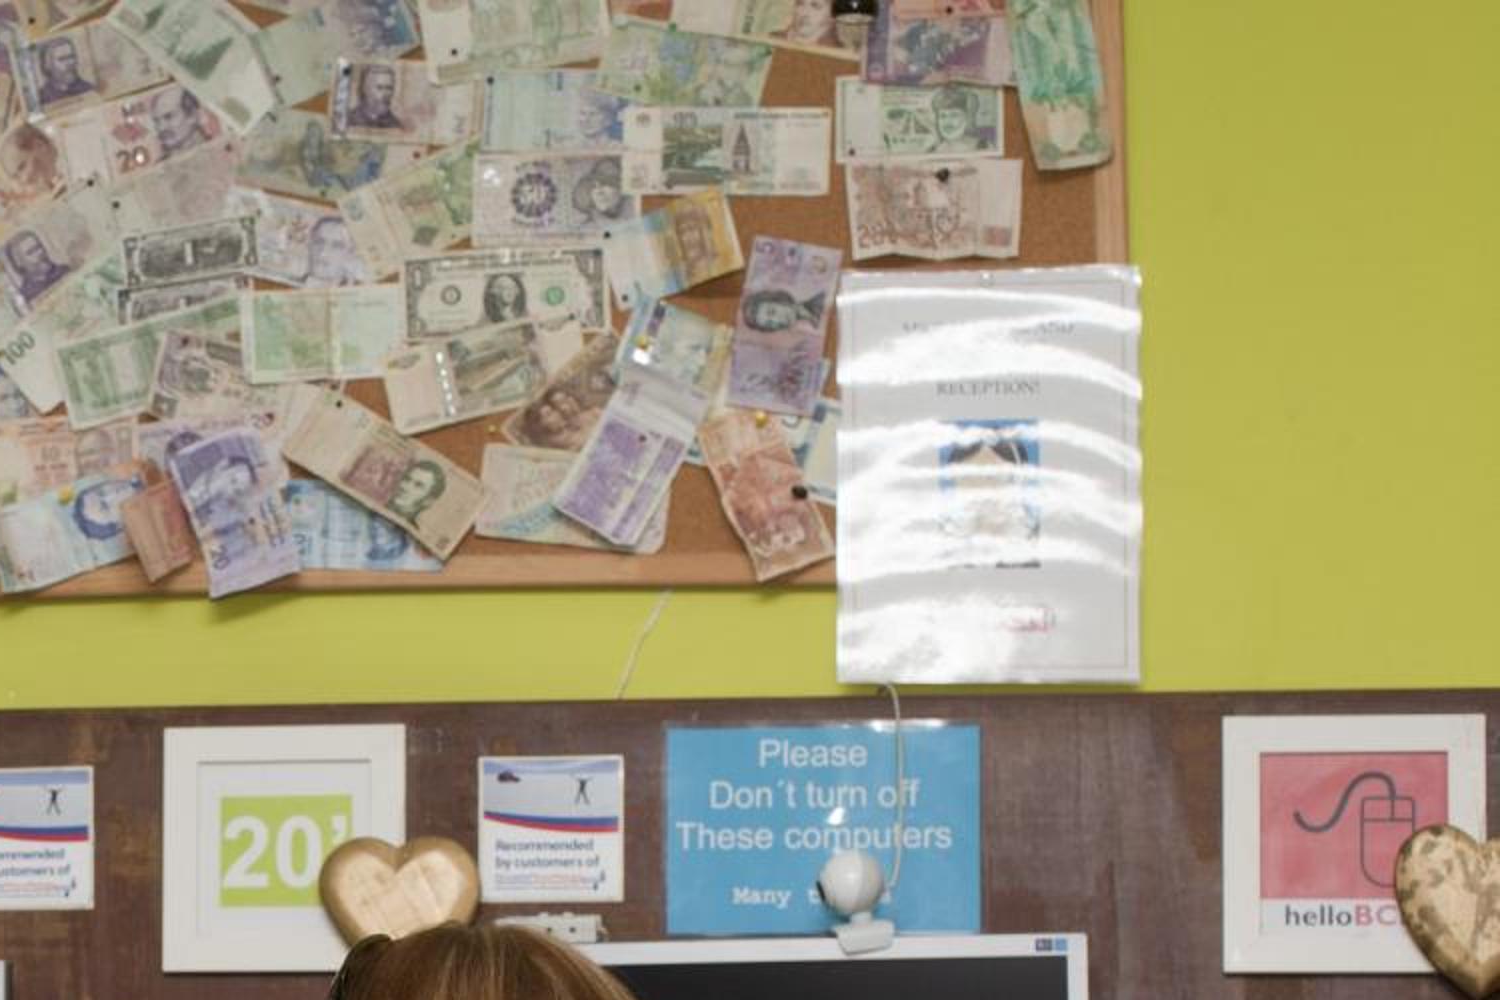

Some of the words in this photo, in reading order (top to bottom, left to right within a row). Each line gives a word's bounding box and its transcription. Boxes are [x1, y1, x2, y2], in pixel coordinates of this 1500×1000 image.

[758, 738, 868, 768] Please
[806, 780, 867, 808] turn
[877, 778, 920, 808] off
[675, 822, 773, 850] These
[784, 820, 952, 853] computers
[732, 887, 791, 908] Many
[1285, 904, 1402, 927] helloBC
